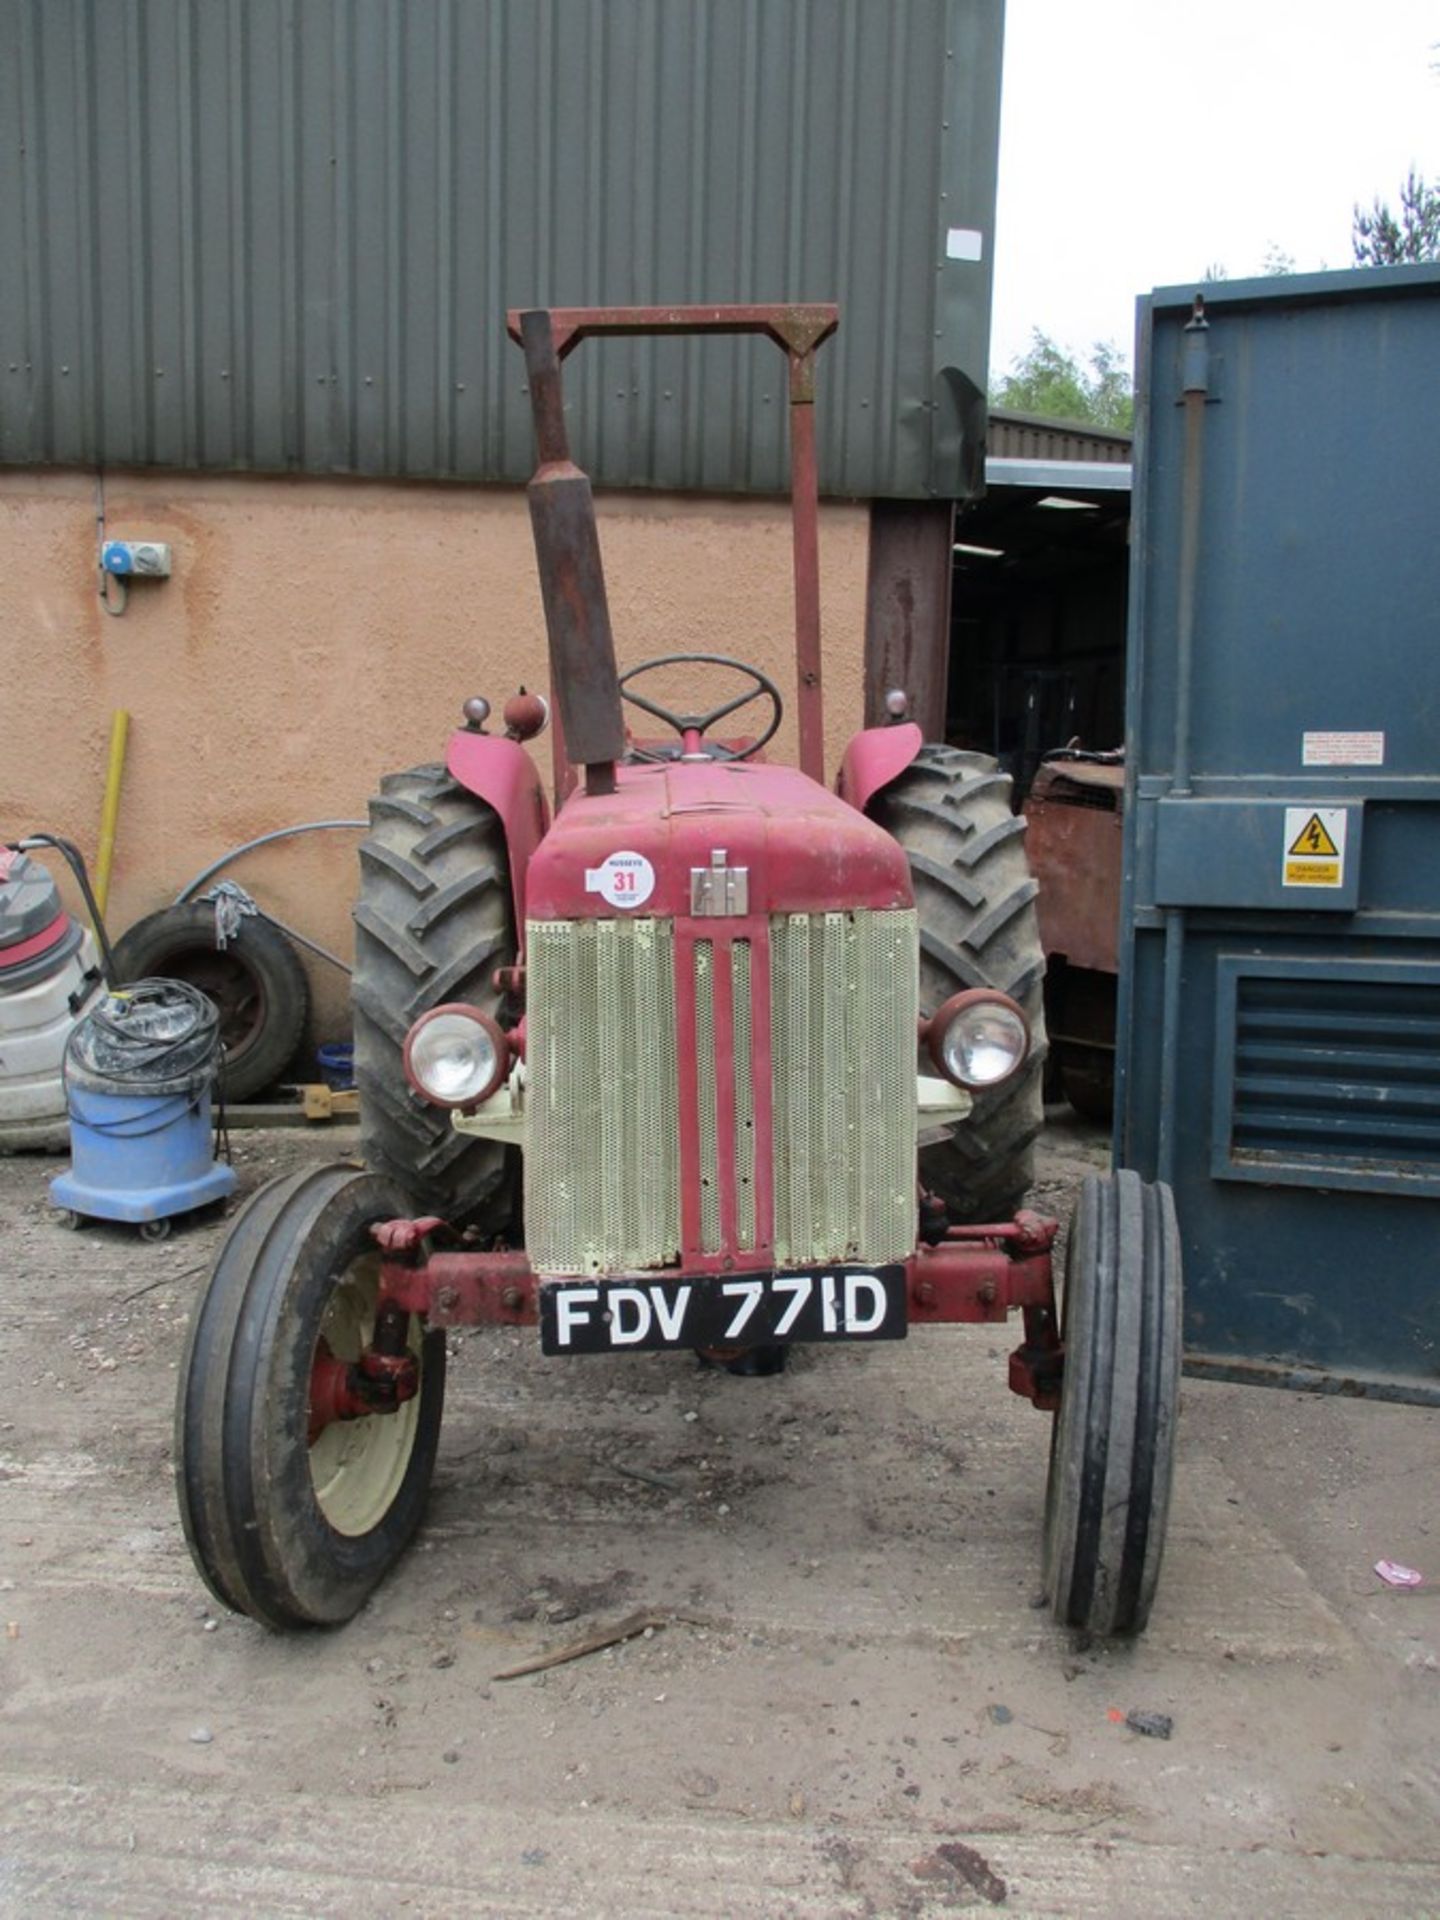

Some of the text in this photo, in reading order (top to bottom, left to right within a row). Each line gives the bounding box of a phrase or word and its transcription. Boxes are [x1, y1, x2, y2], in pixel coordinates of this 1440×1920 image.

[614, 872, 634, 892] 31
[556, 1275, 887, 1345] FDV 771D
